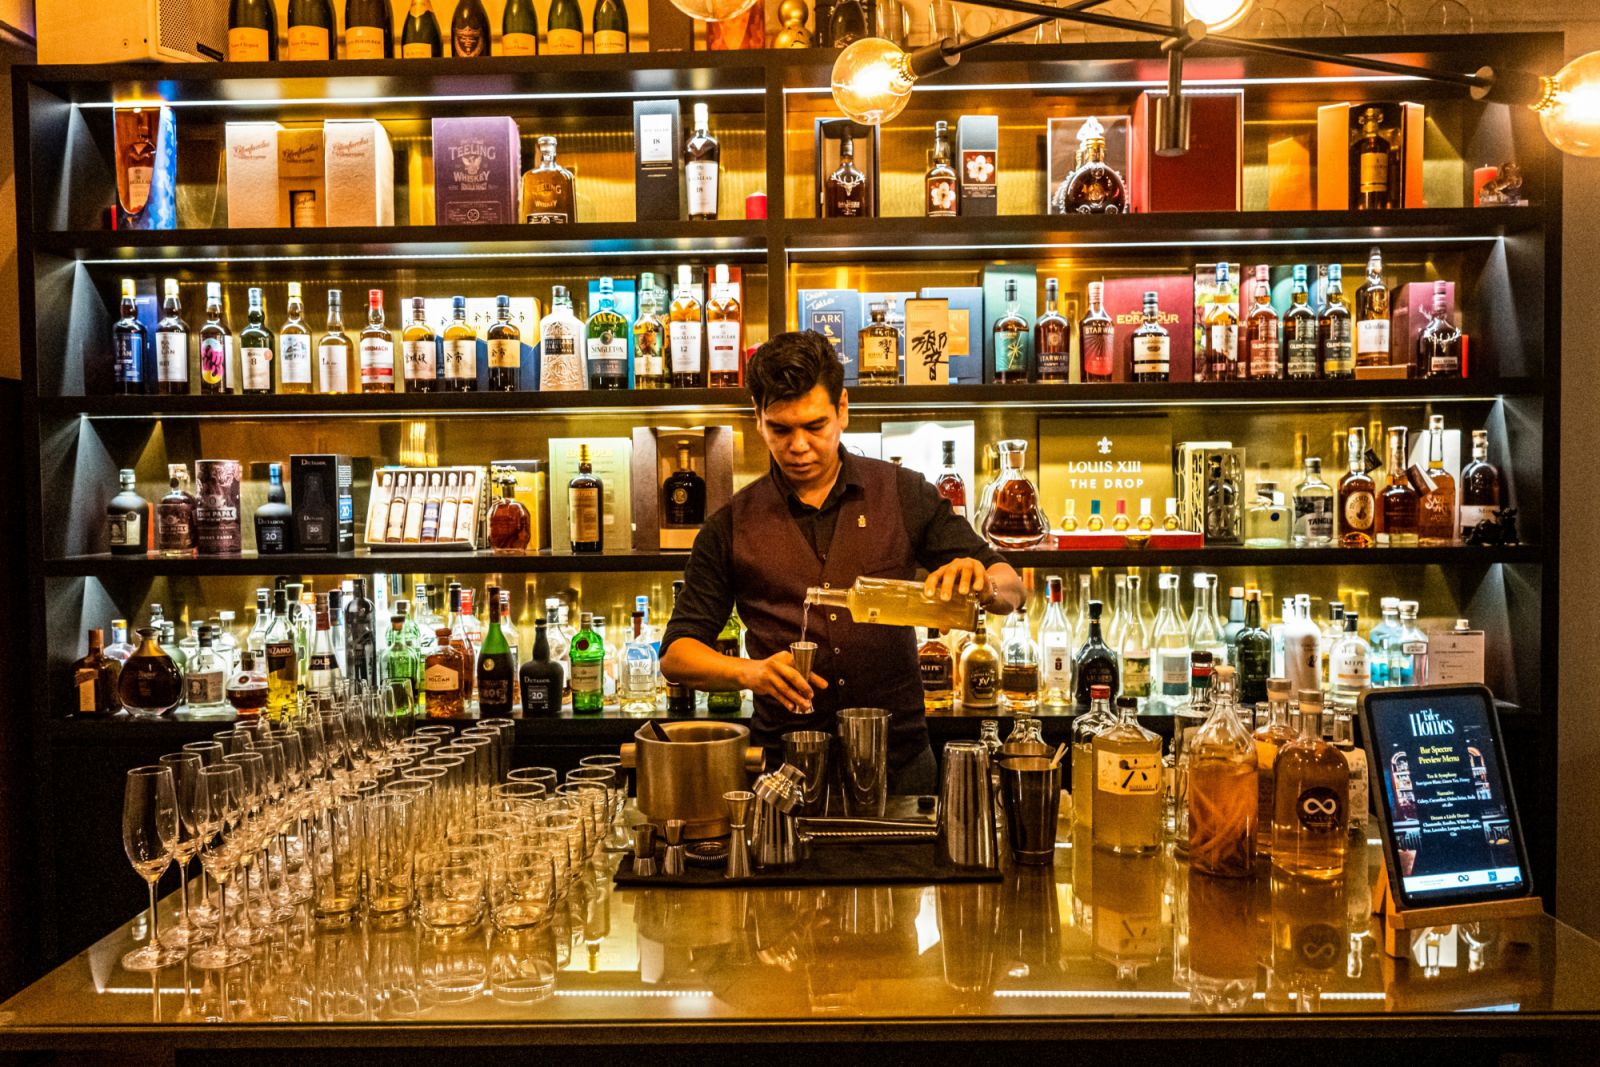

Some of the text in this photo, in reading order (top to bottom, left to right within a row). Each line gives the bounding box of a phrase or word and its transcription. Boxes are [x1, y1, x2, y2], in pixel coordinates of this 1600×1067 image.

[448, 144, 496, 160] TEELING
[453, 170, 490, 182] WHISKEY
[814, 314, 841, 324] LARK
[1116, 314, 1180, 324] EDRAOUR
[912, 330, 949, 381] 響
[1068, 461, 1141, 473] LOUIS XIII
[1070, 479, 1144, 488] THE DROP
[342, 506, 350, 517] 20
[266, 532, 277, 541] 20
[1409, 713, 1455, 736] Homes
[1418, 754, 1460, 764] Preview Menu
